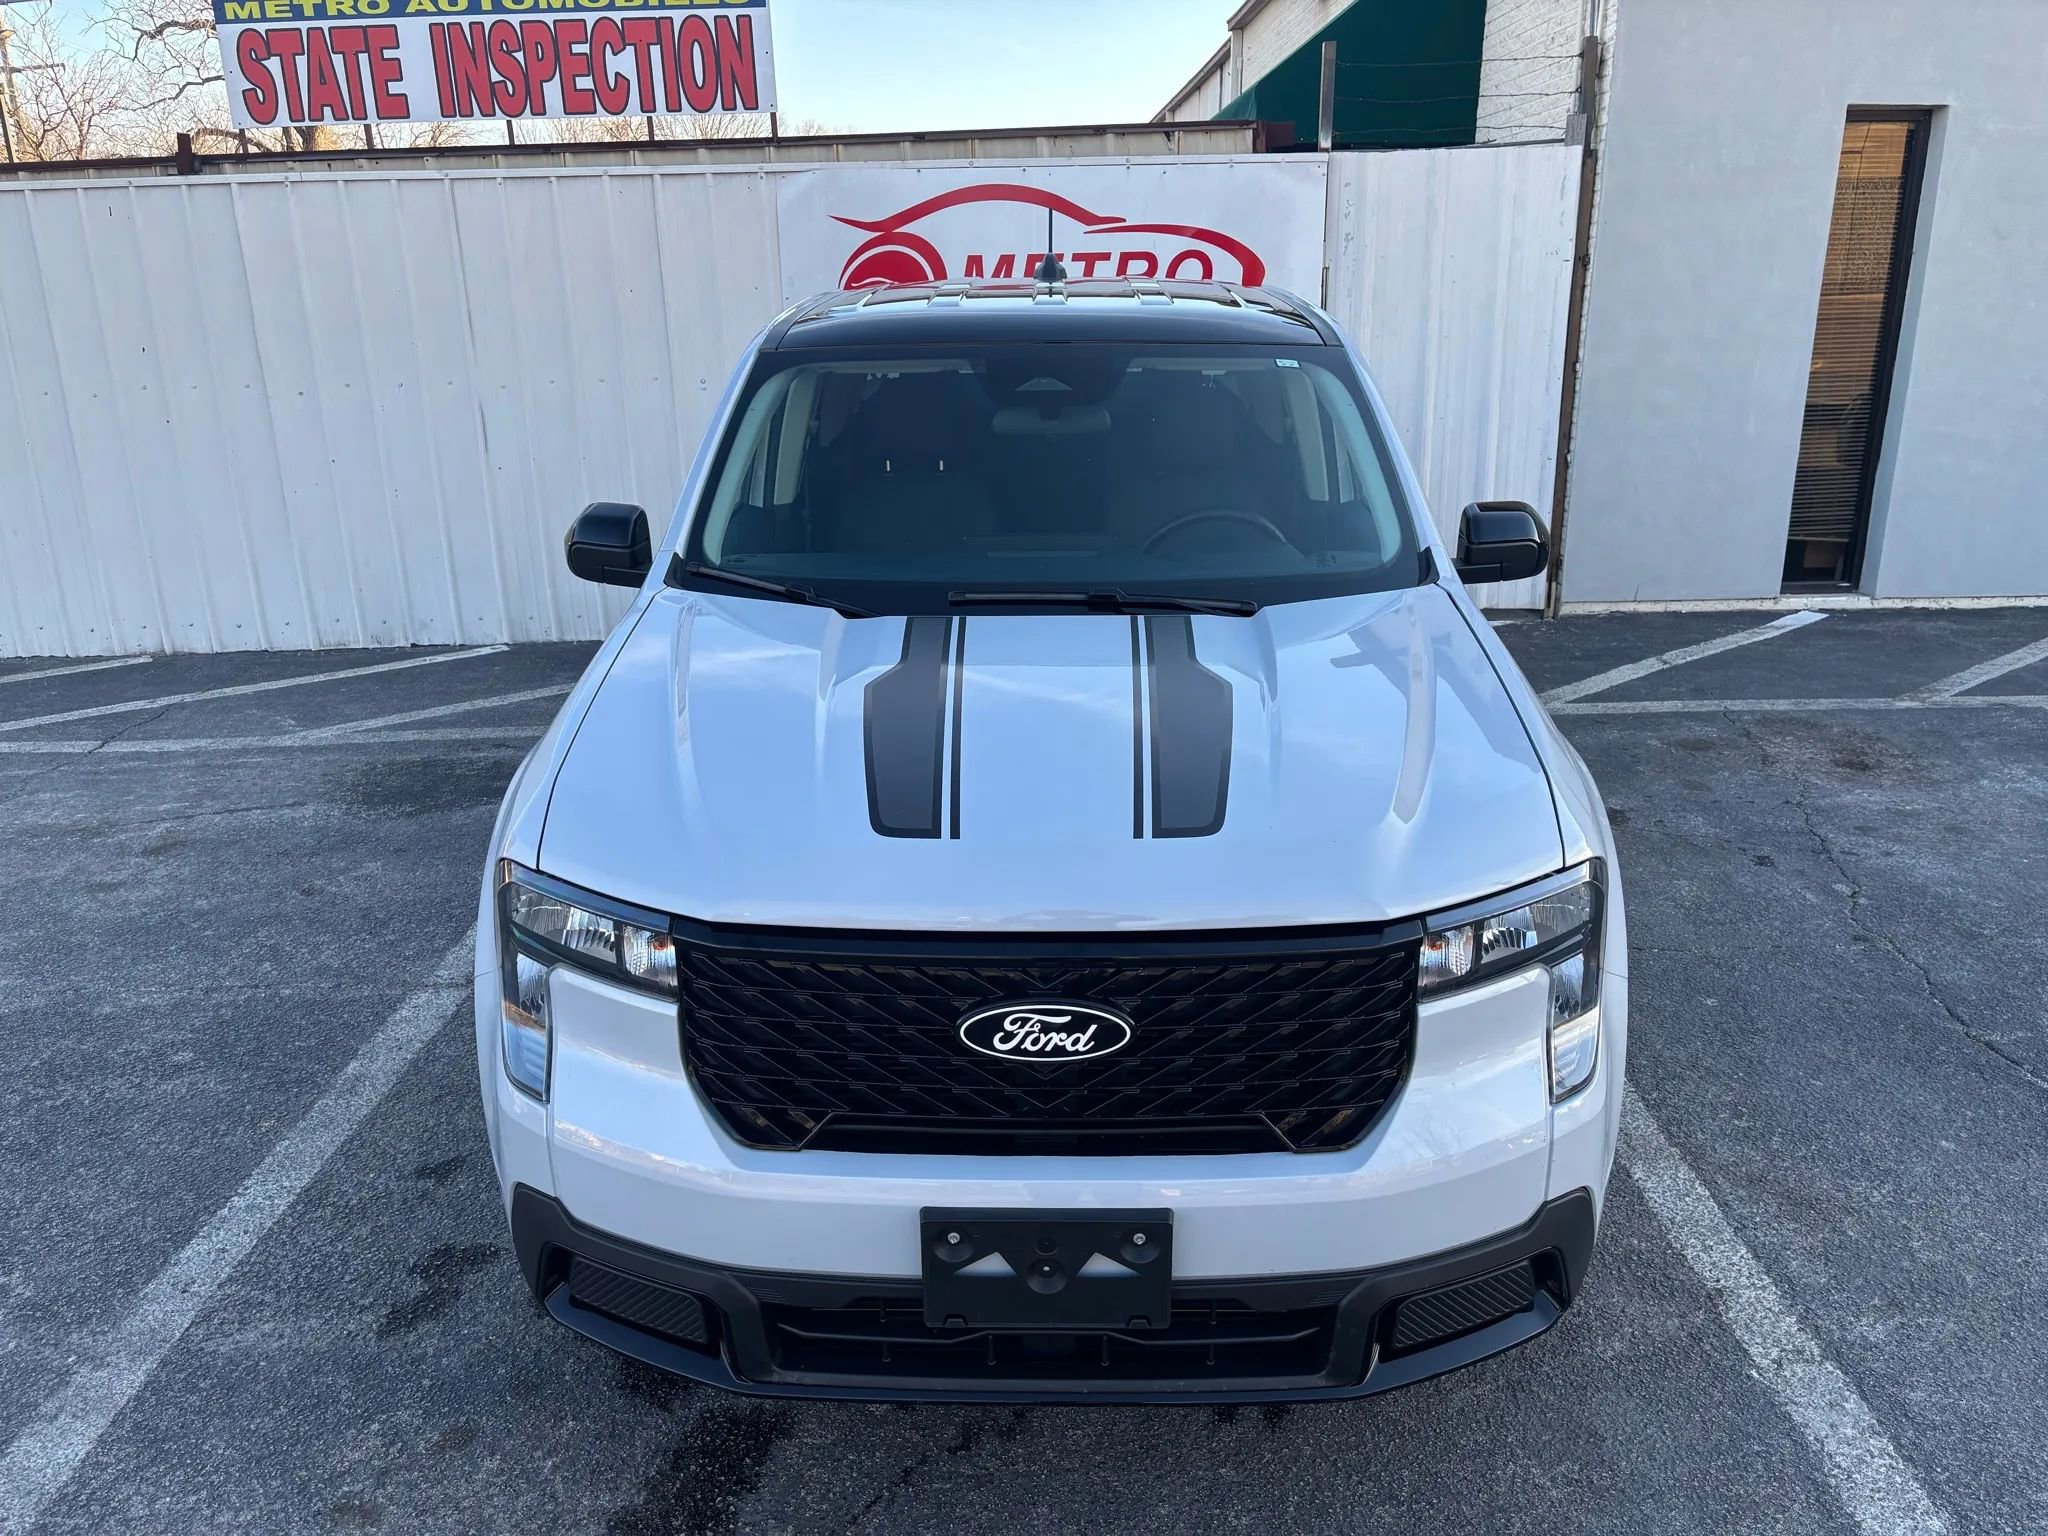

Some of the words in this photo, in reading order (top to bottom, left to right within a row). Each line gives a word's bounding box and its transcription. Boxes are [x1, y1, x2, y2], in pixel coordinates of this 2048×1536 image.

[224, 0, 389, 20] METRO
[236, 25, 410, 125] STATE
[429, 14, 760, 118] INSPECTION
[993, 1013, 1097, 1051] Ford
